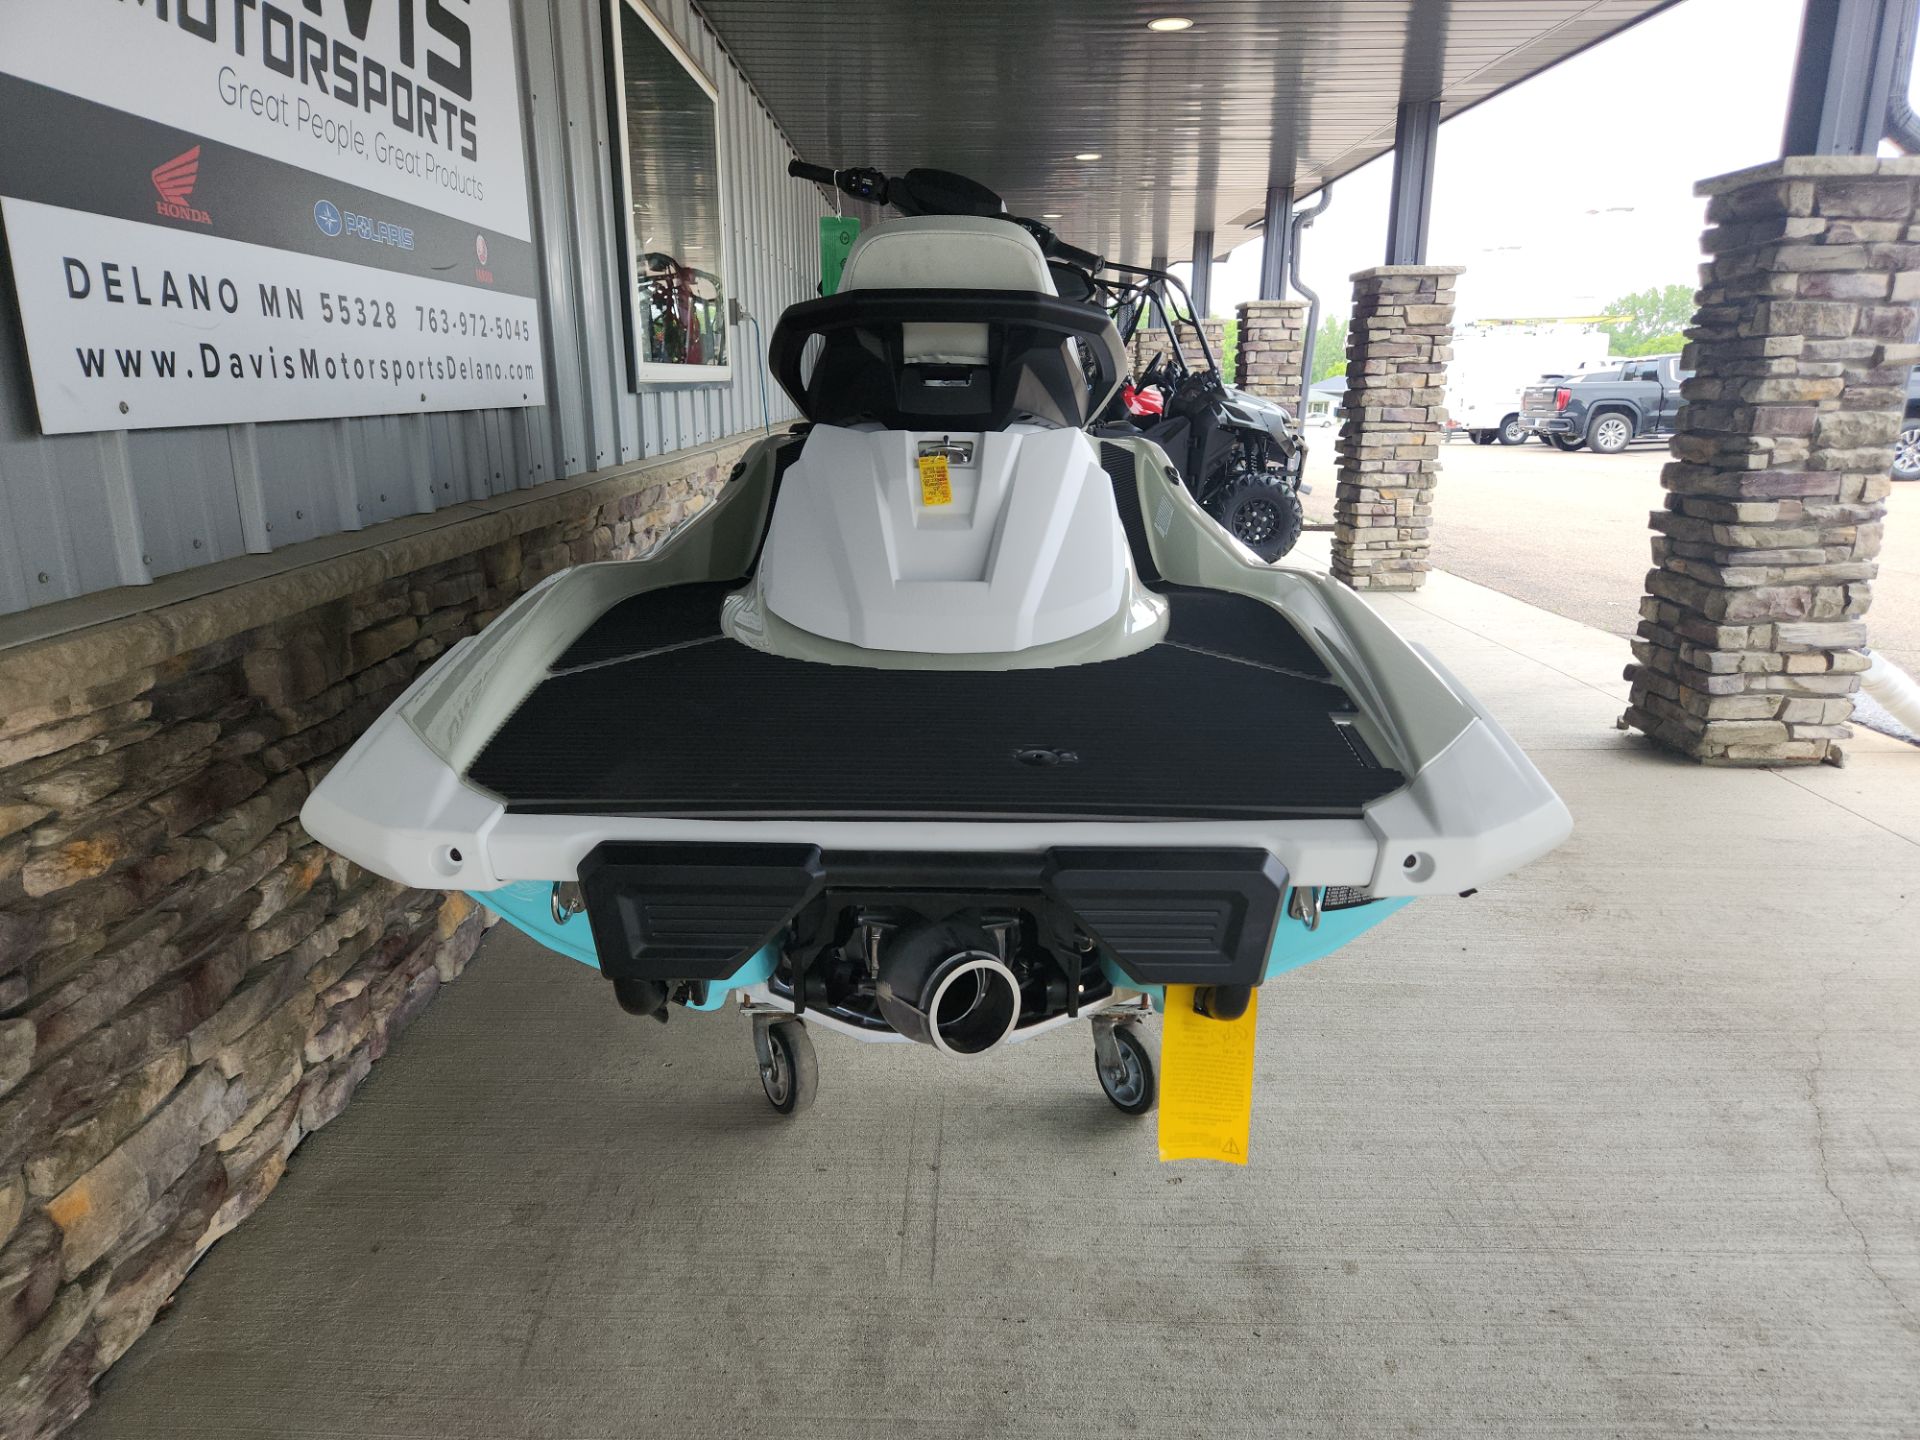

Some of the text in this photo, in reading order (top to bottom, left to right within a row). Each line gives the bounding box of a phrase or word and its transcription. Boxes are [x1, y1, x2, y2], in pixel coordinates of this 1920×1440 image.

[110, 0, 477, 163] OTORSPORTS
[218, 66, 484, 202] Great People, Great Products
[155, 201, 213, 225] HONDA
[344, 211, 415, 251] POLARIS
[62, 256, 530, 342] DELANO MN 55328 763-972-5045
[76, 343, 535, 386] www.DavisMotorsportsDelano.com
